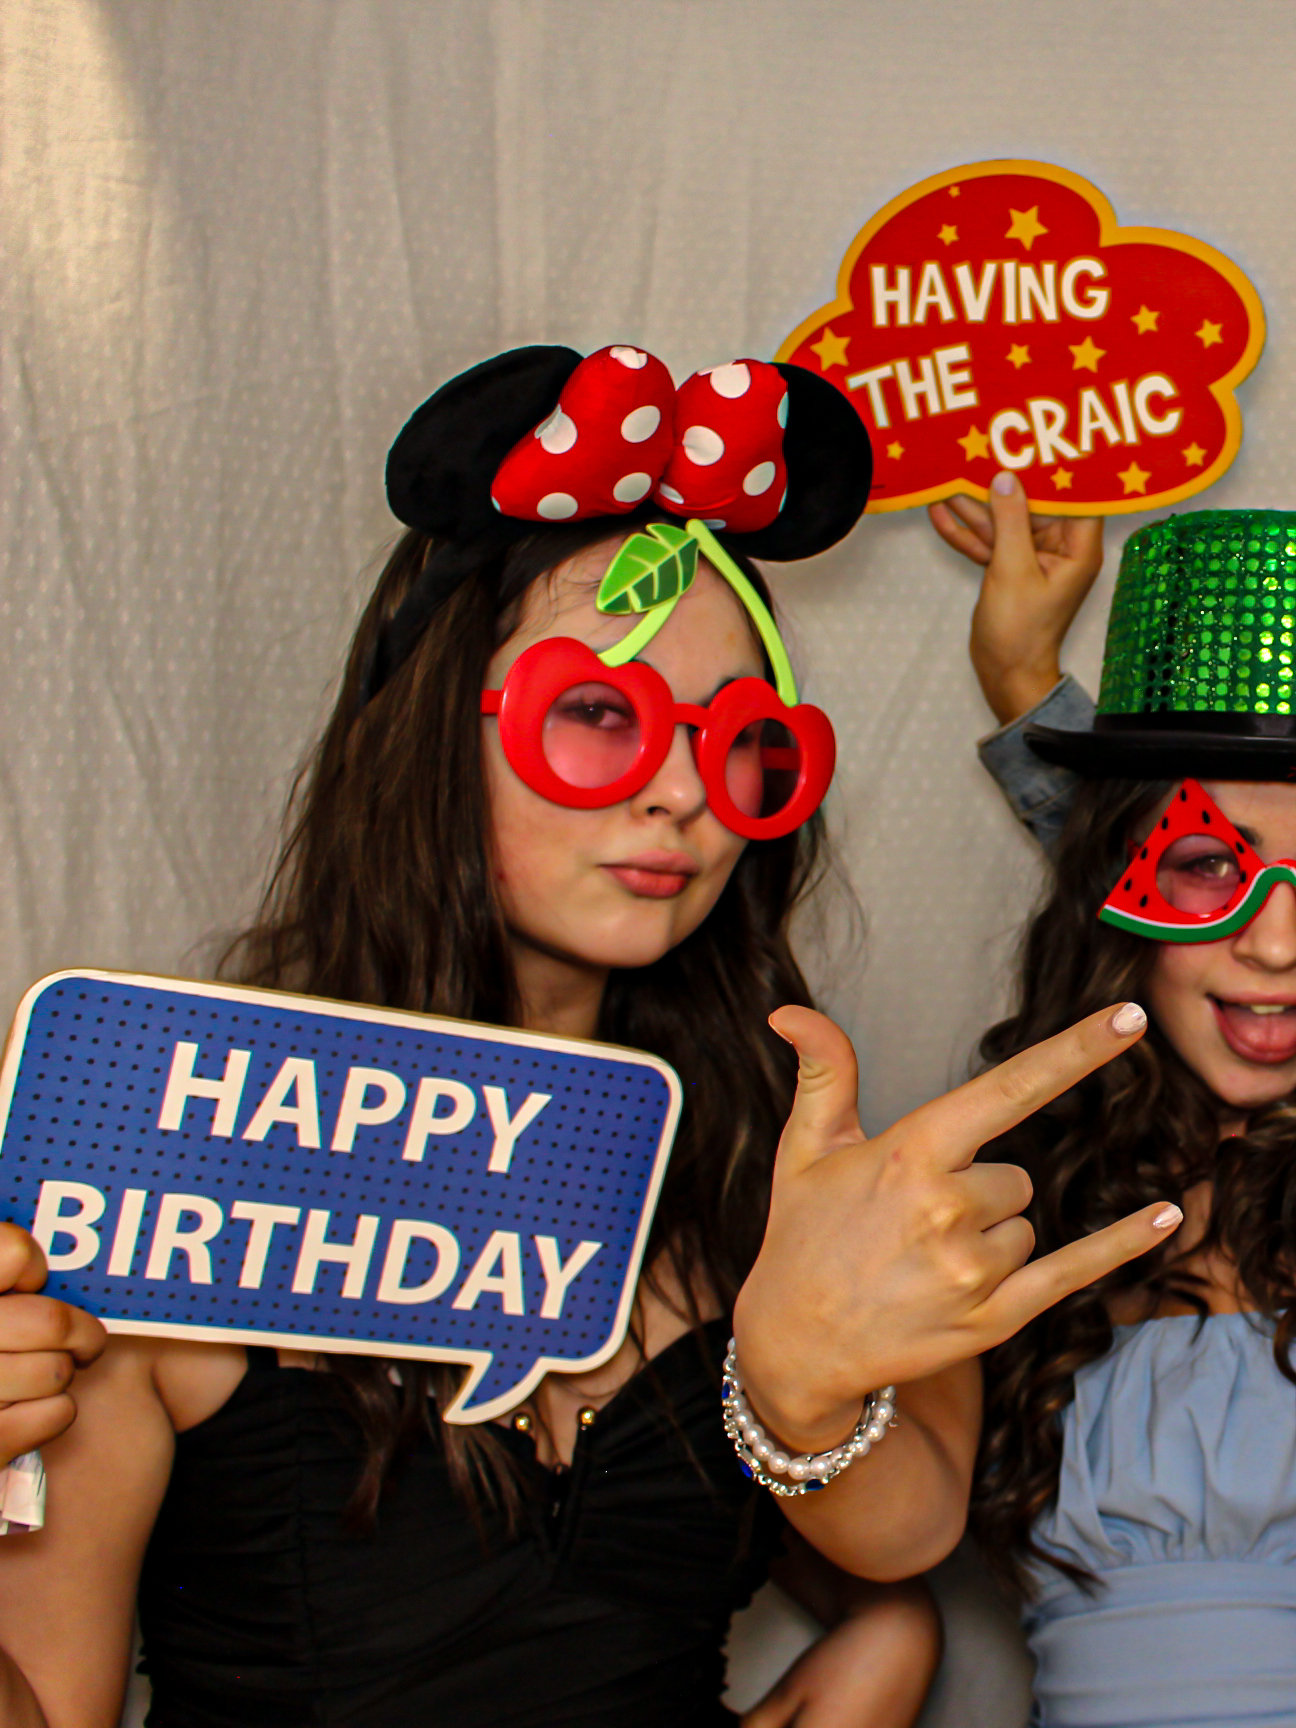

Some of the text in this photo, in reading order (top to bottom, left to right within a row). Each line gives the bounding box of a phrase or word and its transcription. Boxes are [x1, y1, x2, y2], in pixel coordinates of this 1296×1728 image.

[870, 259, 1109, 326] HAVING
[848, 345, 977, 428] THE
[990, 375, 1181, 469] CRAIC
[158, 1041, 552, 1173] HAPPY
[31, 1179, 602, 1320] BIRTHDAY
